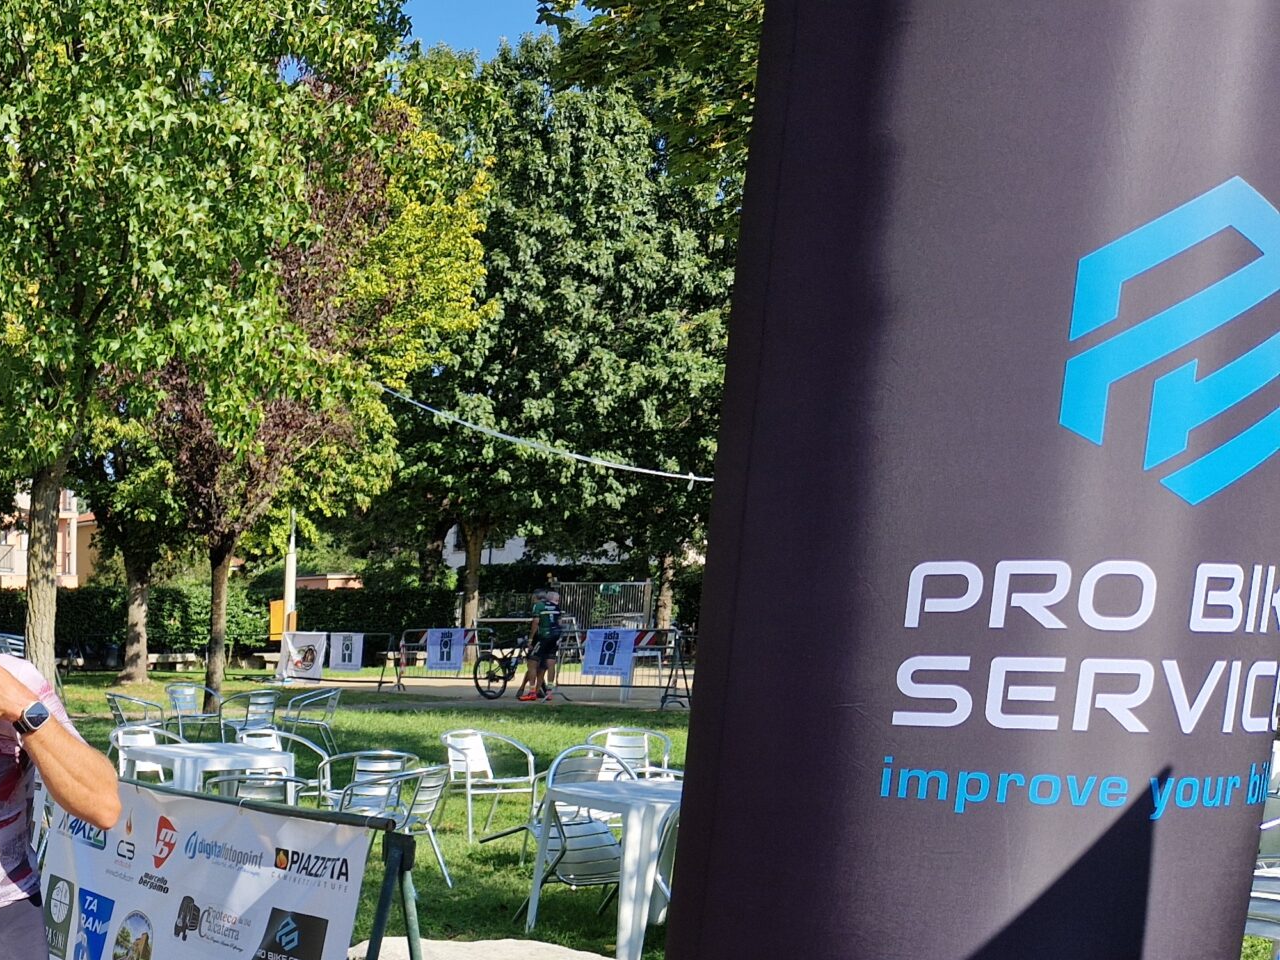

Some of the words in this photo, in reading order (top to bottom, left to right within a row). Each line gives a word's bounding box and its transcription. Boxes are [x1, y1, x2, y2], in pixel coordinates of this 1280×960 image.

[904, 560, 1157, 632] PRO
[891, 655, 1280, 734] SERVIC
[880, 755, 1128, 814] improve
[1149, 775, 1241, 820] your
[198, 840, 264, 870] digitalfotopoint
[138, 876, 170, 894] bergamo
[143, 872, 168, 887] marcello
[84, 895, 98, 913] TA
[207, 906, 238, 926] Enoteca
[80, 914, 103, 936] RAN
[198, 909, 240, 941] Calcaterra
